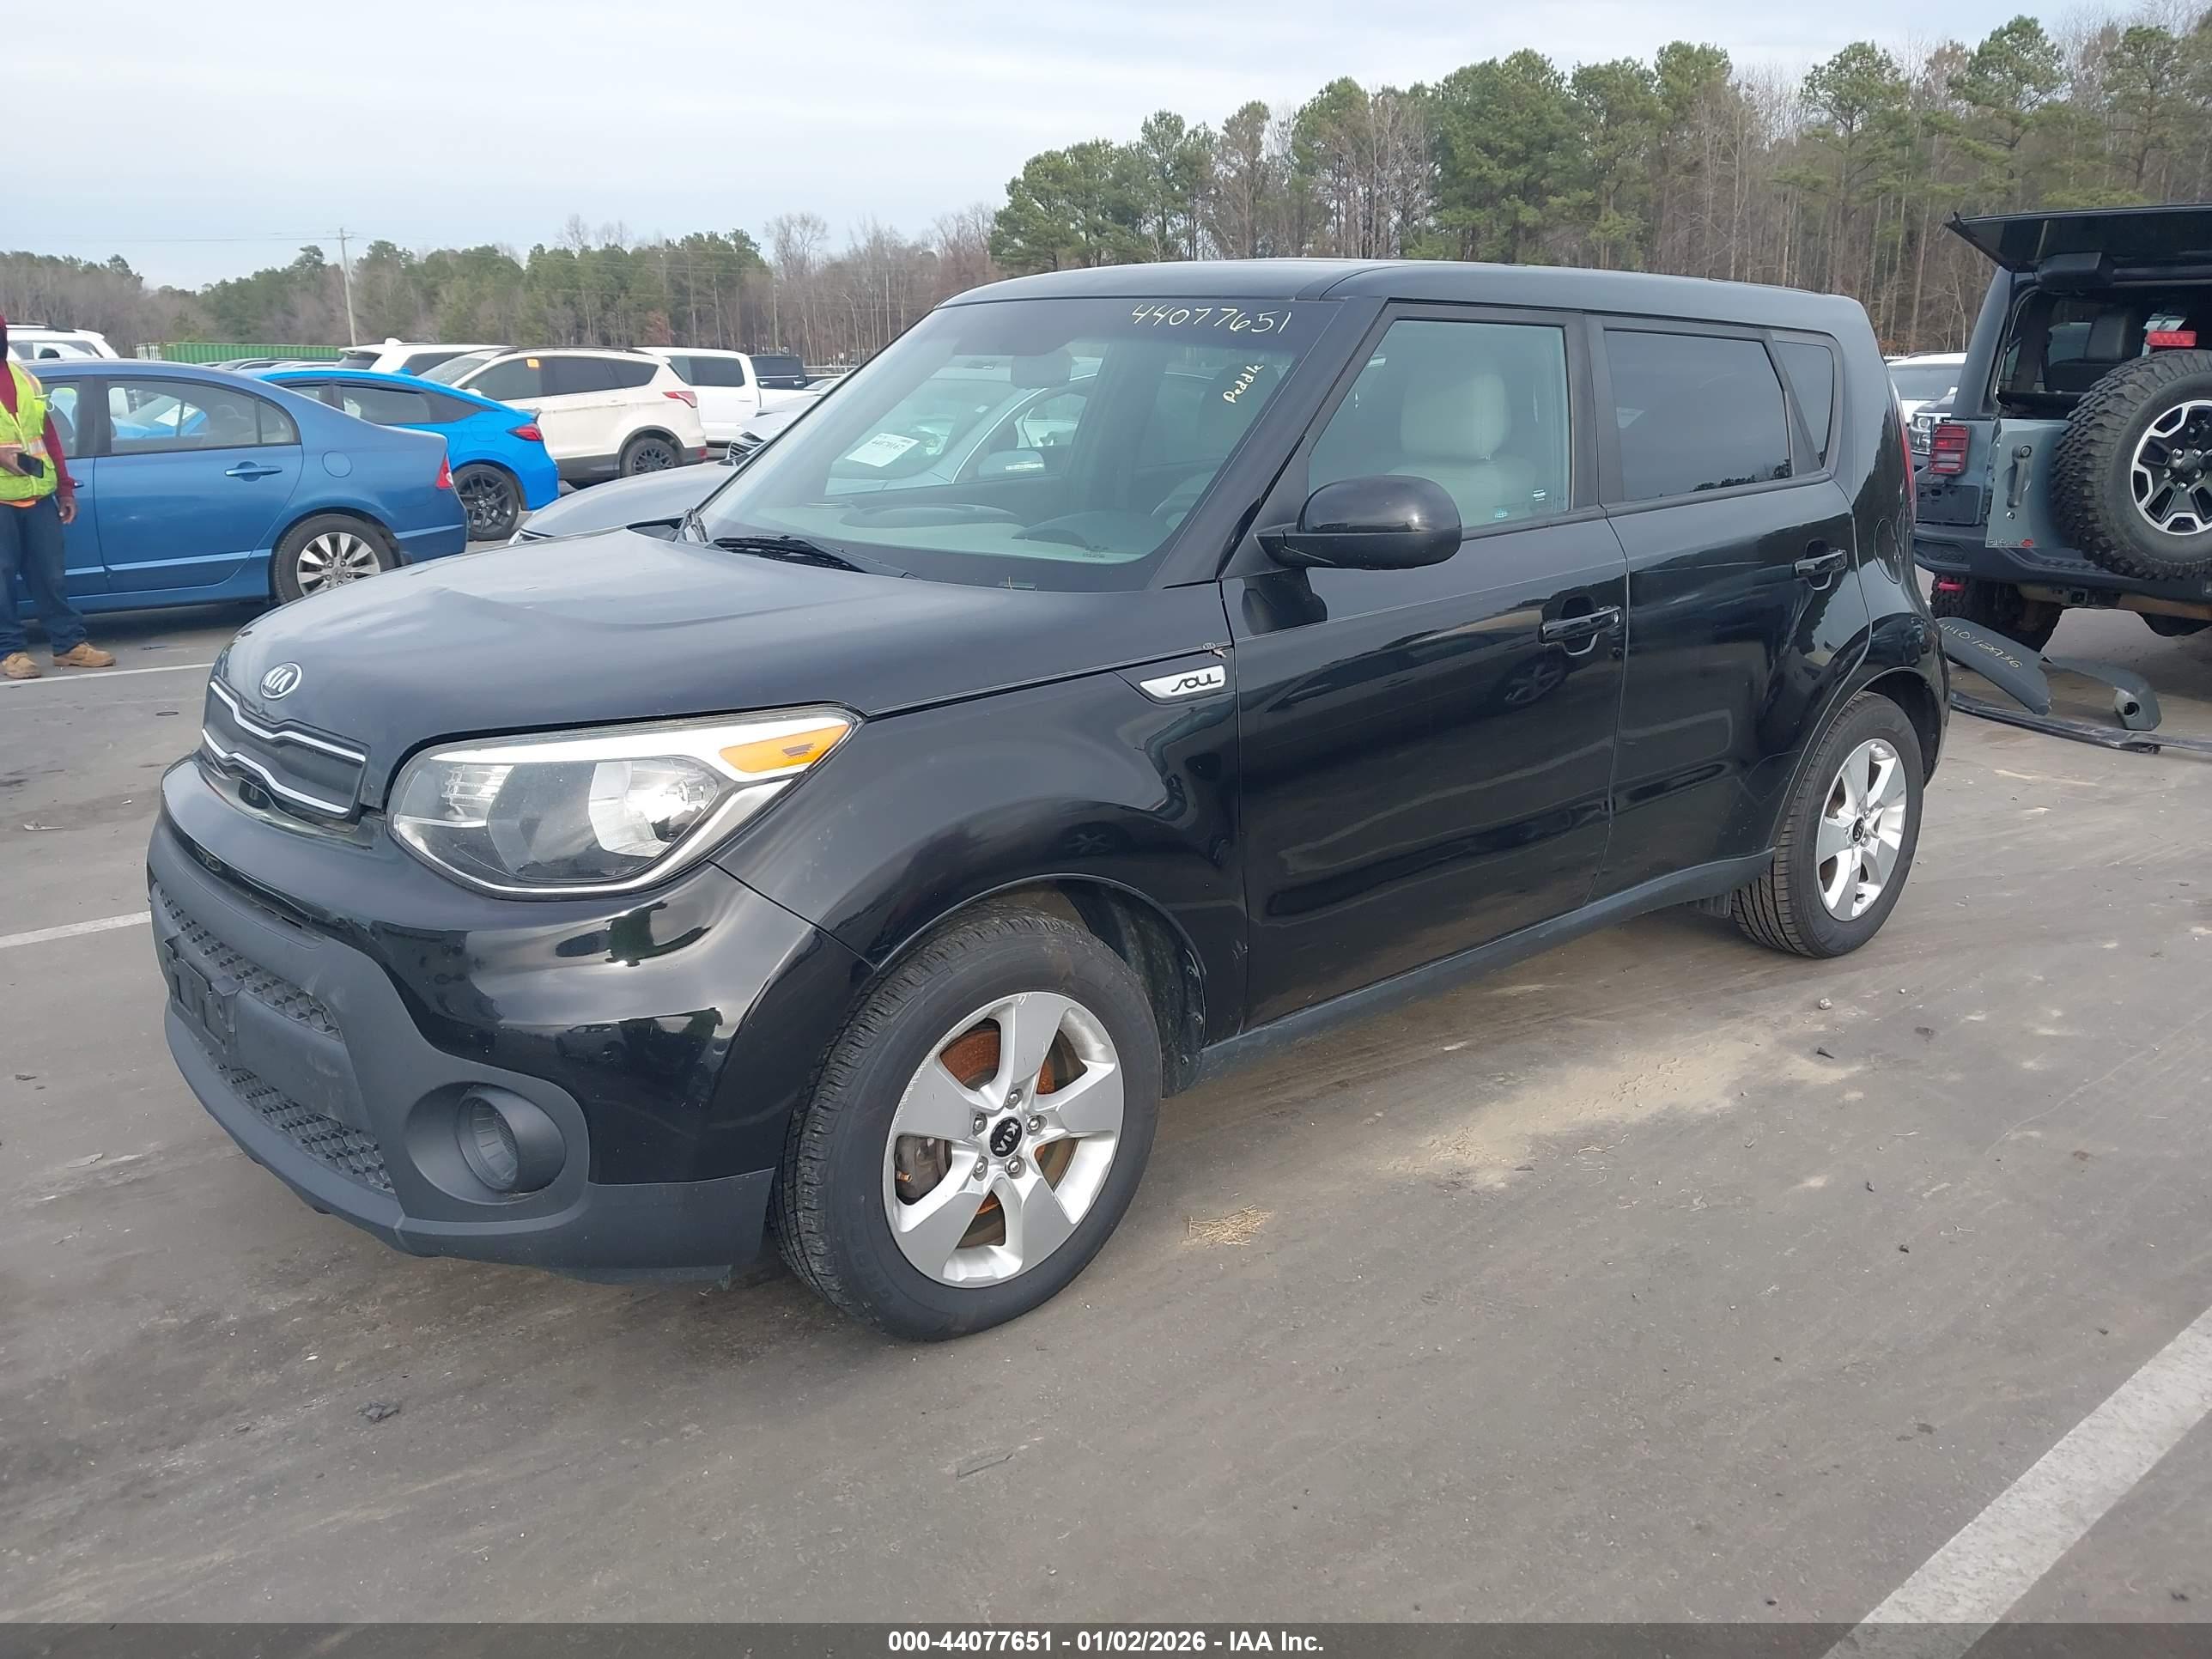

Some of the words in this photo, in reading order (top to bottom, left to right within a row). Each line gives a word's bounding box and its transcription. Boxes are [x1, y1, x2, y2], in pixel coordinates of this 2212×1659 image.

[1132, 303, 1292, 334] 44077651
[264, 665, 295, 694] KIA
[1170, 673, 1222, 693] SOUL
[995, 1121, 1019, 1152] KIA
